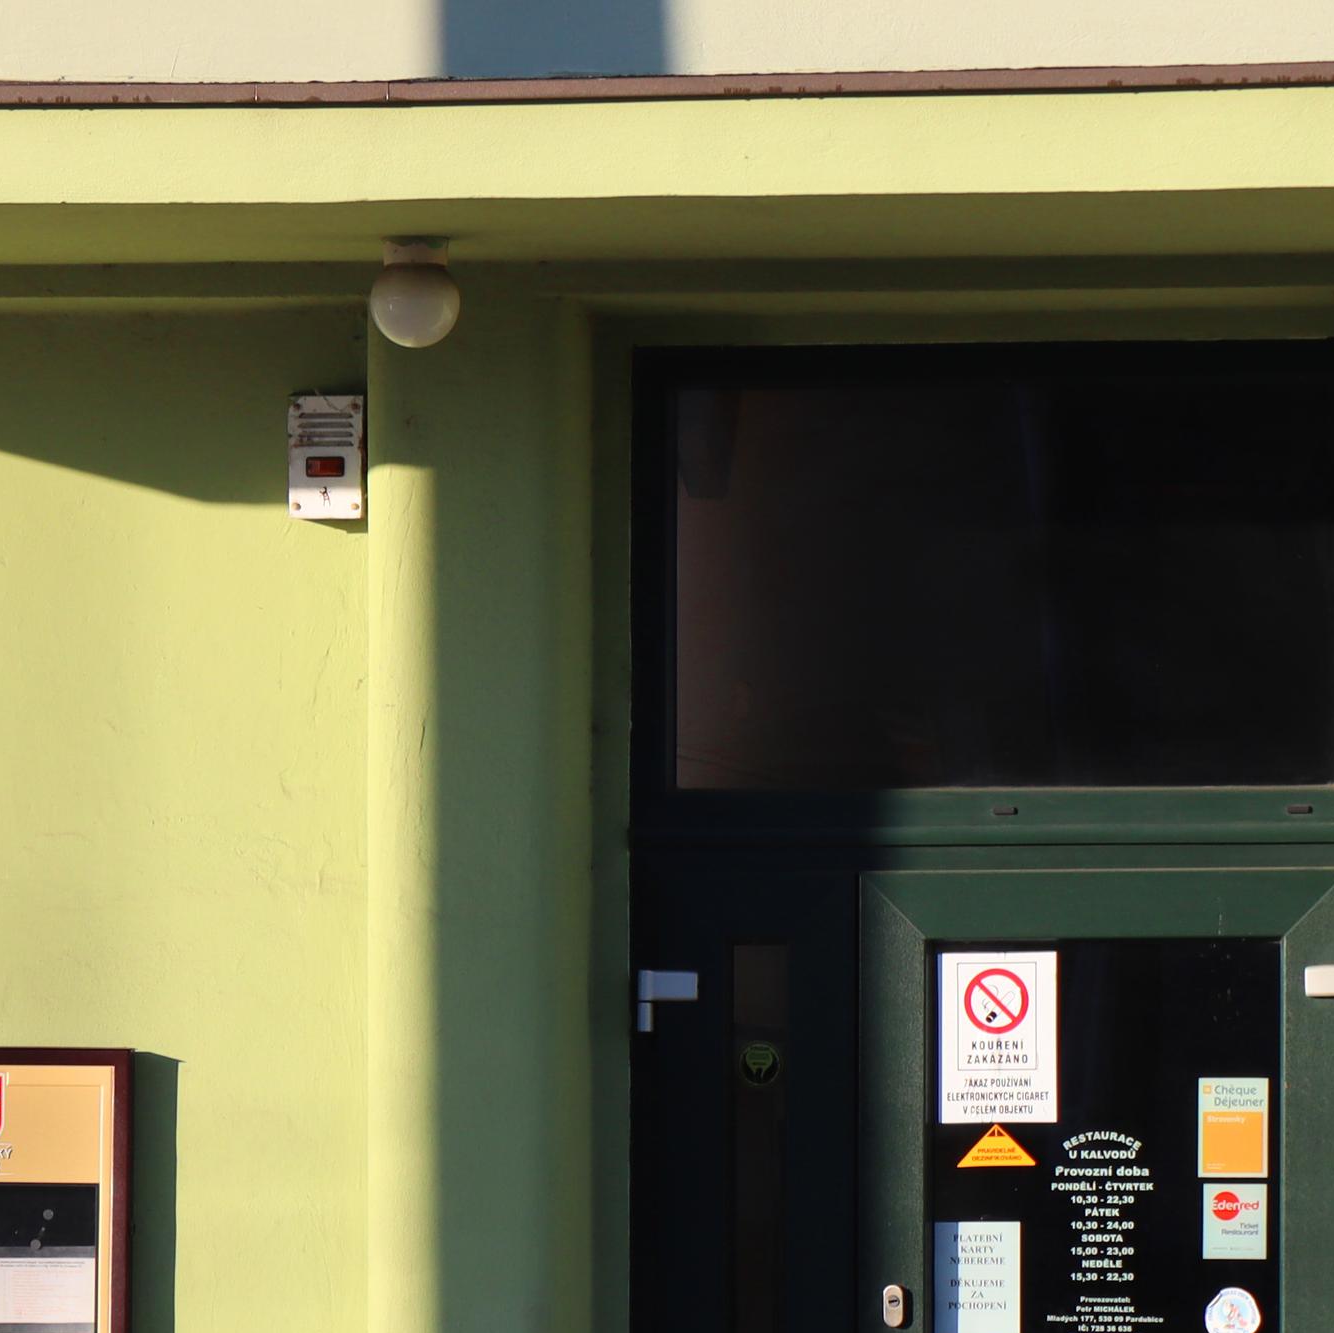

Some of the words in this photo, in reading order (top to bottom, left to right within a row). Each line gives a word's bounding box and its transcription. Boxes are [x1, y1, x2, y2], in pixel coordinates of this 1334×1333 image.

[972, 1037, 1024, 1050] KOUŘENÍ
[1016, 1091, 1049, 1101] CIGARET
[1214, 1096, 1264, 1108] Déjeuner
[962, 1105, 968, 1115] V
[998, 1104, 1033, 1114] OBJEKTU
[1062, 1130, 1142, 1151] RESTAURACE
[1068, 1150, 1077, 1159] U
[1080, 1148, 1136, 1159] KALVODŮ
[1055, 1166, 1113, 1177] Provozní
[1116, 1166, 1150, 1177] doba
[1051, 1181, 1096, 1191] PONDĚLÍ
[1105, 1181, 1154, 1191] ČTVRTEK
[1070, 1195, 1098, 1205] 10,30
[1106, 1195, 1135, 1205] 22,30
[1212, 1199, 1260, 1211] Edenred
[1085, 1207, 1120, 1217] PÁTEK
[1070, 1221, 1098, 1231] 10,30
[1106, 1221, 1135, 1231] 24,00
[953, 1232, 1003, 1243] PLATEBNÍ
[1081, 1234, 1123, 1243] SOBOTA
[960, 1245, 995, 1253] KARTY
[1070, 1247, 1098, 1256] 15,00
[1106, 1247, 1135, 1256] 23,00
[950, 1257, 1006, 1265] NEBEREME
[1081, 1258, 1123, 1268] NEDĚLE
[950, 1278, 1005, 1287] DĚKUJEME
[1070, 1273, 1098, 1282] 15,30
[1106, 1273, 1135, 1282] 22,30
[971, 1291, 984, 1299] ZA
[948, 1302, 1007, 1310] POCHOPENÍ
[1076, 1305, 1092, 1313] Petr
[1093, 1305, 1135, 1313] MICHÁLEK
